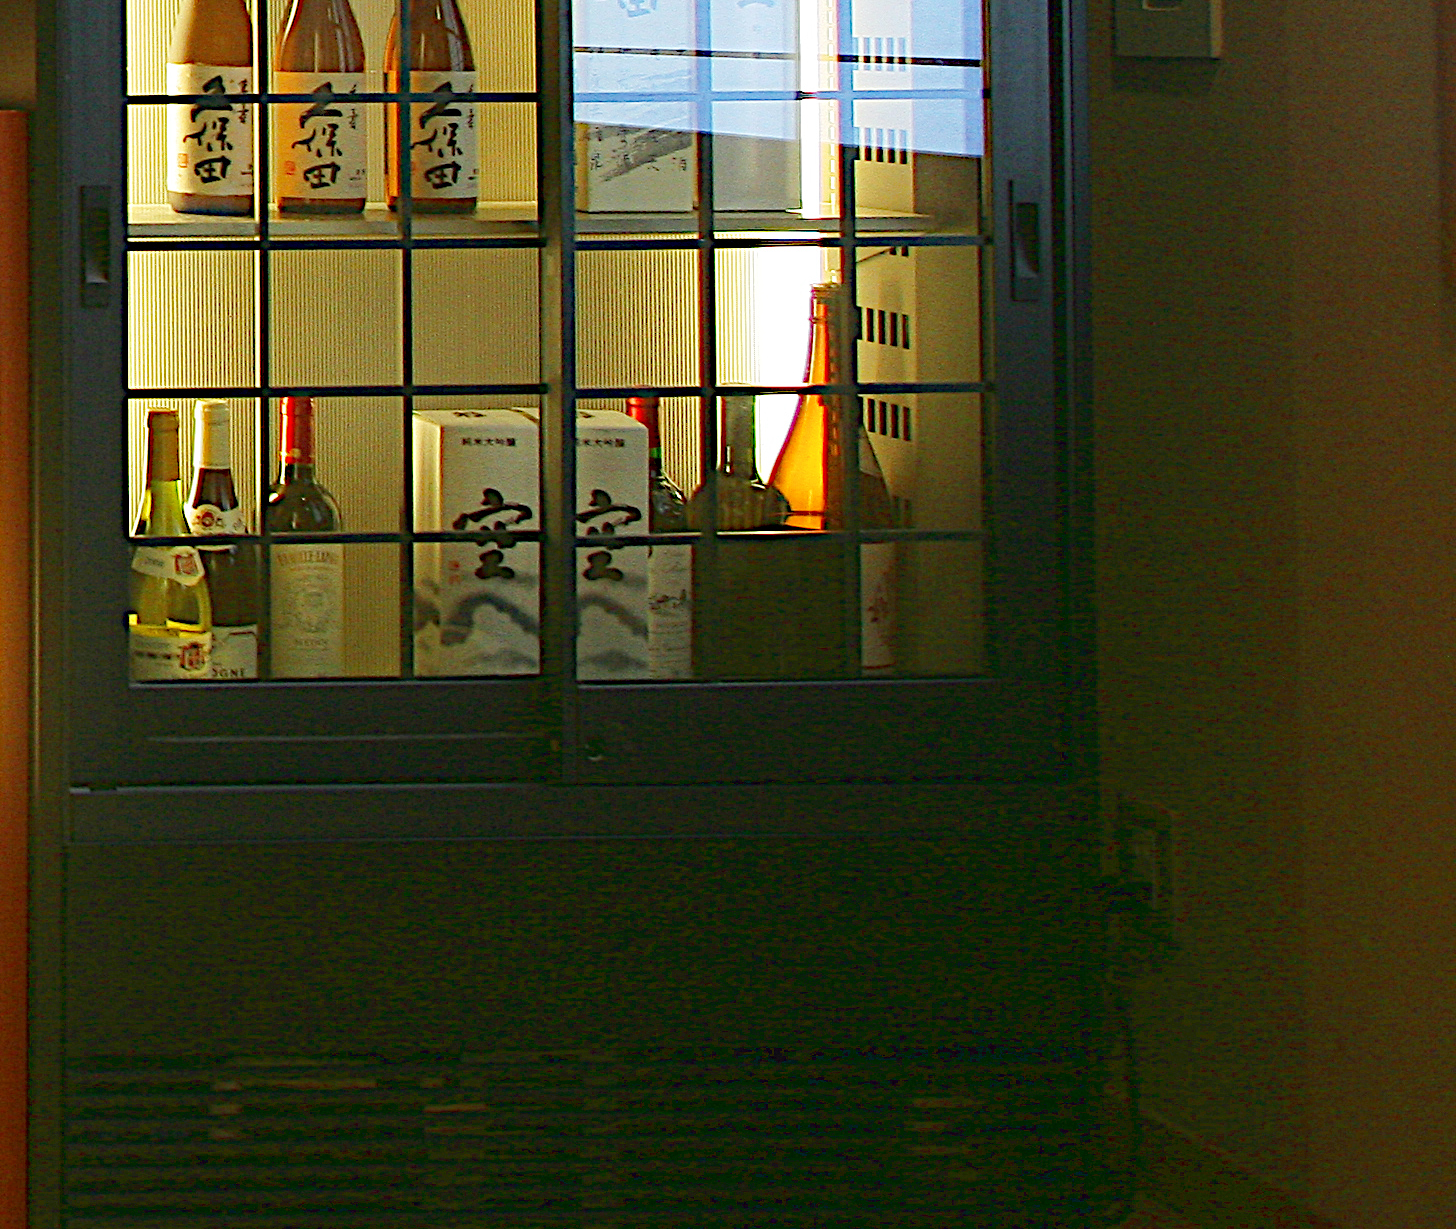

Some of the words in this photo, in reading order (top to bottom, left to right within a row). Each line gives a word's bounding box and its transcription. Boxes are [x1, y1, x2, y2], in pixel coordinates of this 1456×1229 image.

[183, 75, 233, 184] 久保田
[291, 81, 343, 189] 久保田
[410, 81, 463, 189] 久保田
